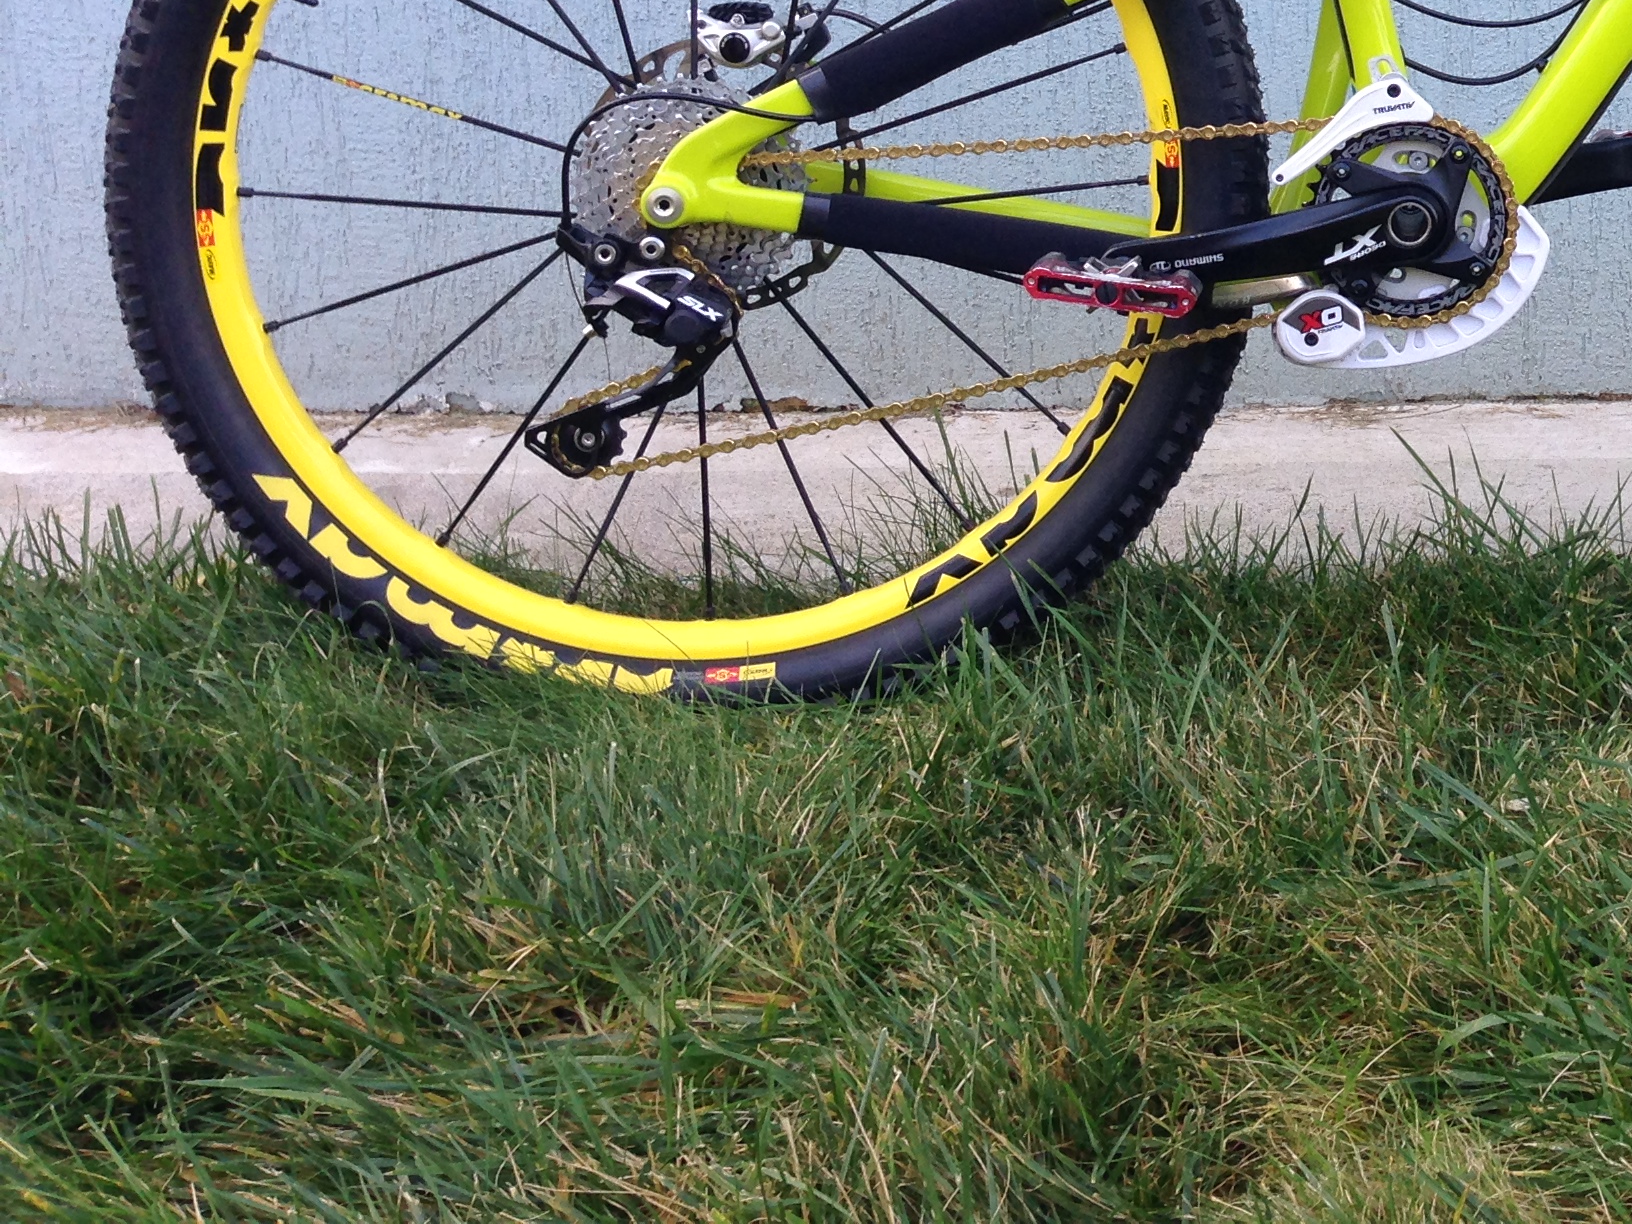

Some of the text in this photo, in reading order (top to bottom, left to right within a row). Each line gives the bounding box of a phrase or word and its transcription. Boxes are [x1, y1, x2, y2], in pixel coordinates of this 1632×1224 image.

[1372, 101, 1416, 115] TRUVATIV
[1323, 223, 1383, 267] XT
[1350, 240, 1388, 262] DEORE
[1174, 252, 1225, 269] SHIMANO
[676, 294, 725, 323] SLX
